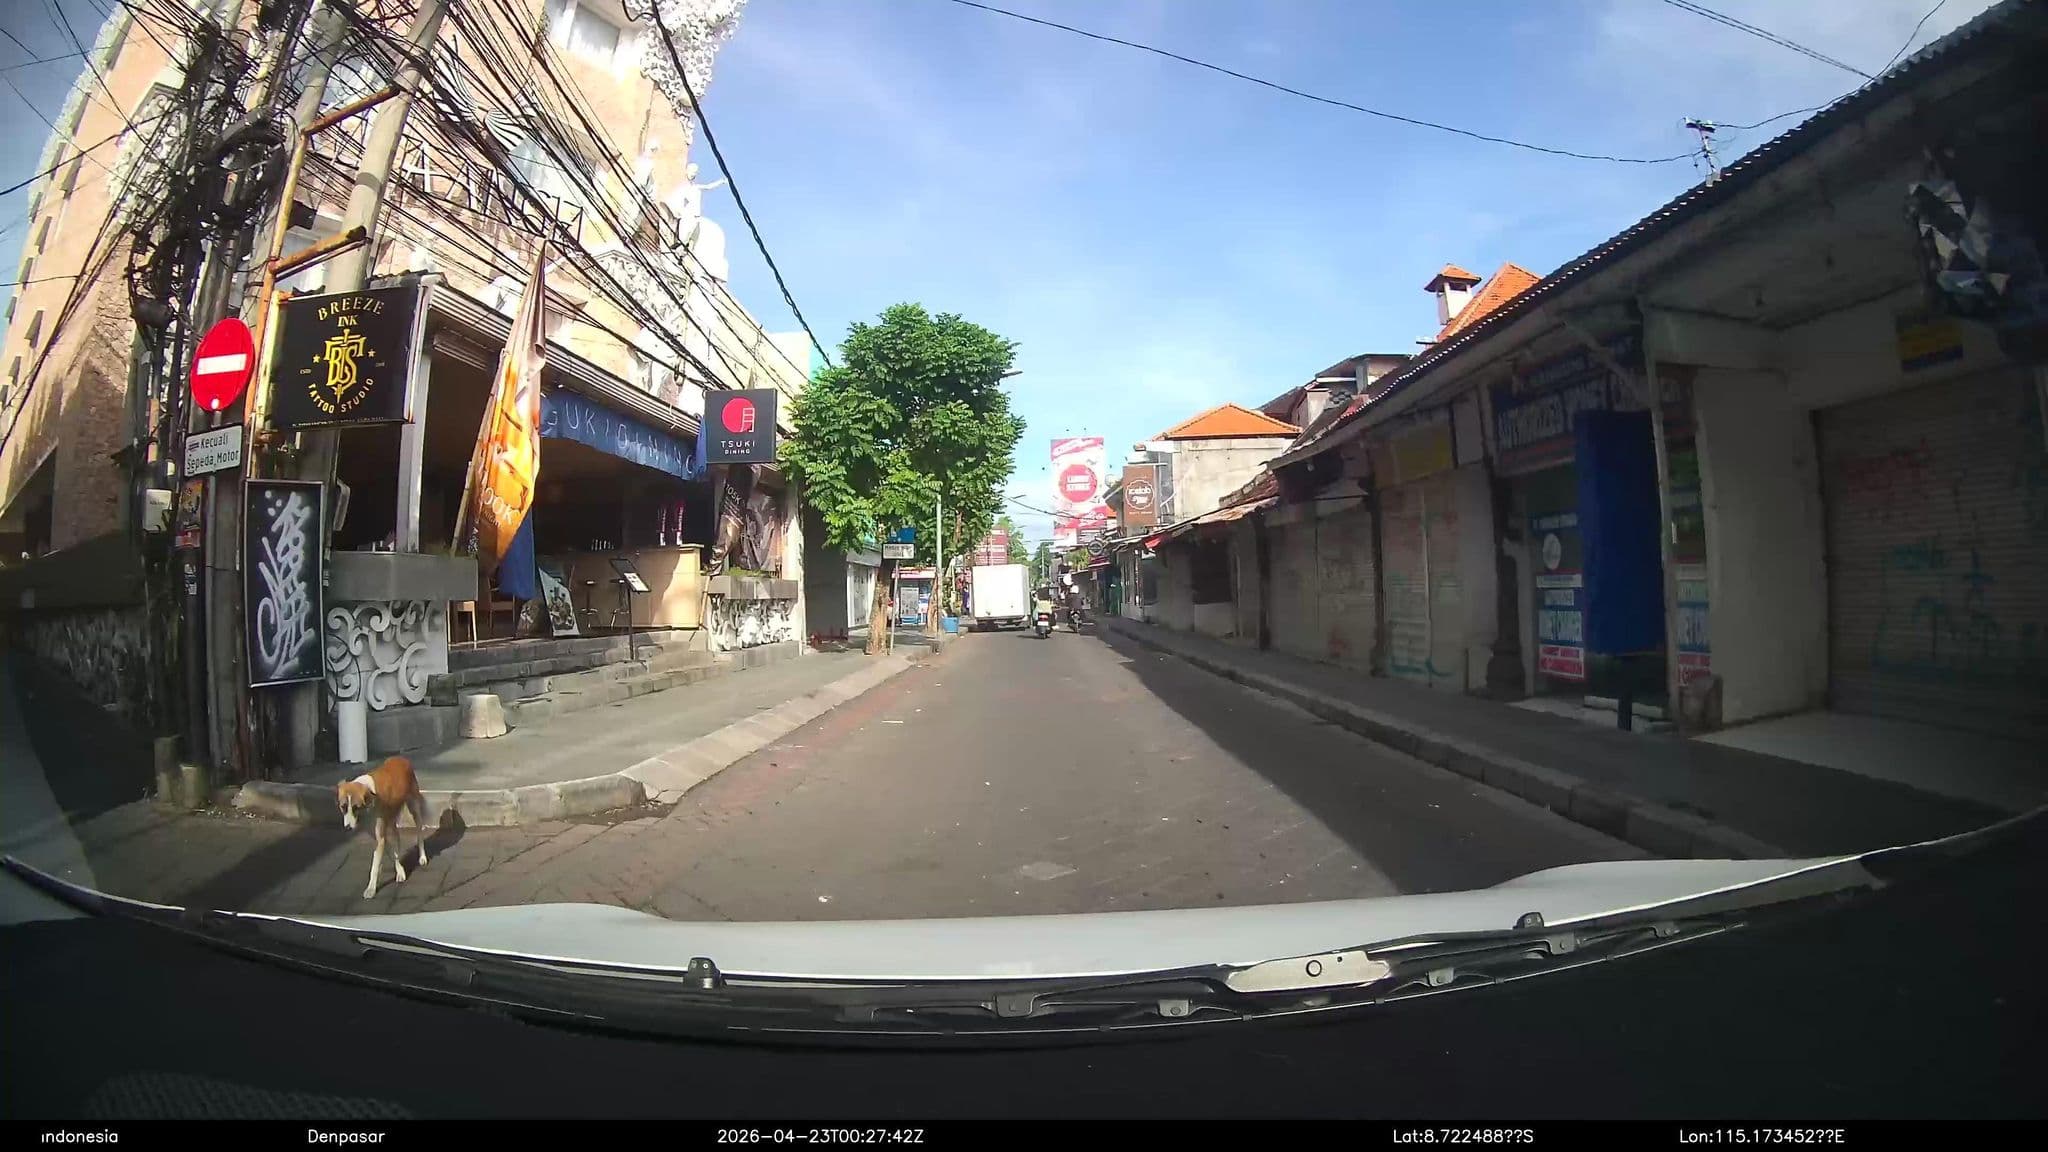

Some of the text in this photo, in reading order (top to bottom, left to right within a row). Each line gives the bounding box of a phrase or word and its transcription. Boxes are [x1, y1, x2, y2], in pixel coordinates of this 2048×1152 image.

[318, 297, 385, 321] BREEZE
[338, 315, 359, 327] INK
[308, 378, 375, 414] TATTOO STUDIO
[201, 433, 228, 449] Kecuali
[721, 440, 755, 448] TSUKI
[187, 449, 239, 471] Sepeda Motor
